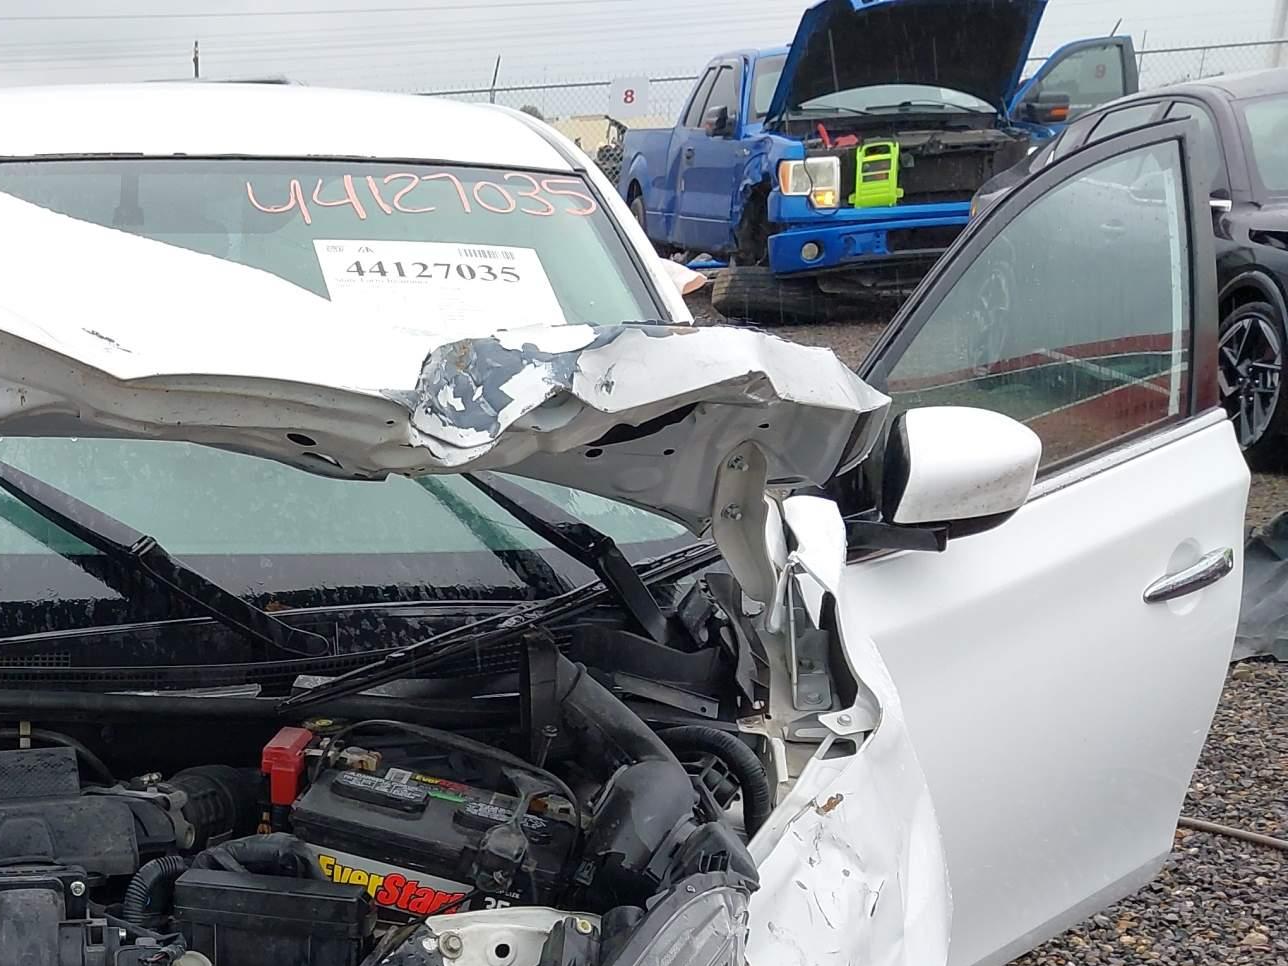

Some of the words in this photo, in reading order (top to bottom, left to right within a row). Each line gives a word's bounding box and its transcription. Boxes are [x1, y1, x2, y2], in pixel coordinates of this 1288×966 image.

[624, 89, 634, 104] 8
[246, 173, 597, 225] 44127035
[346, 260, 521, 283] 44127035
